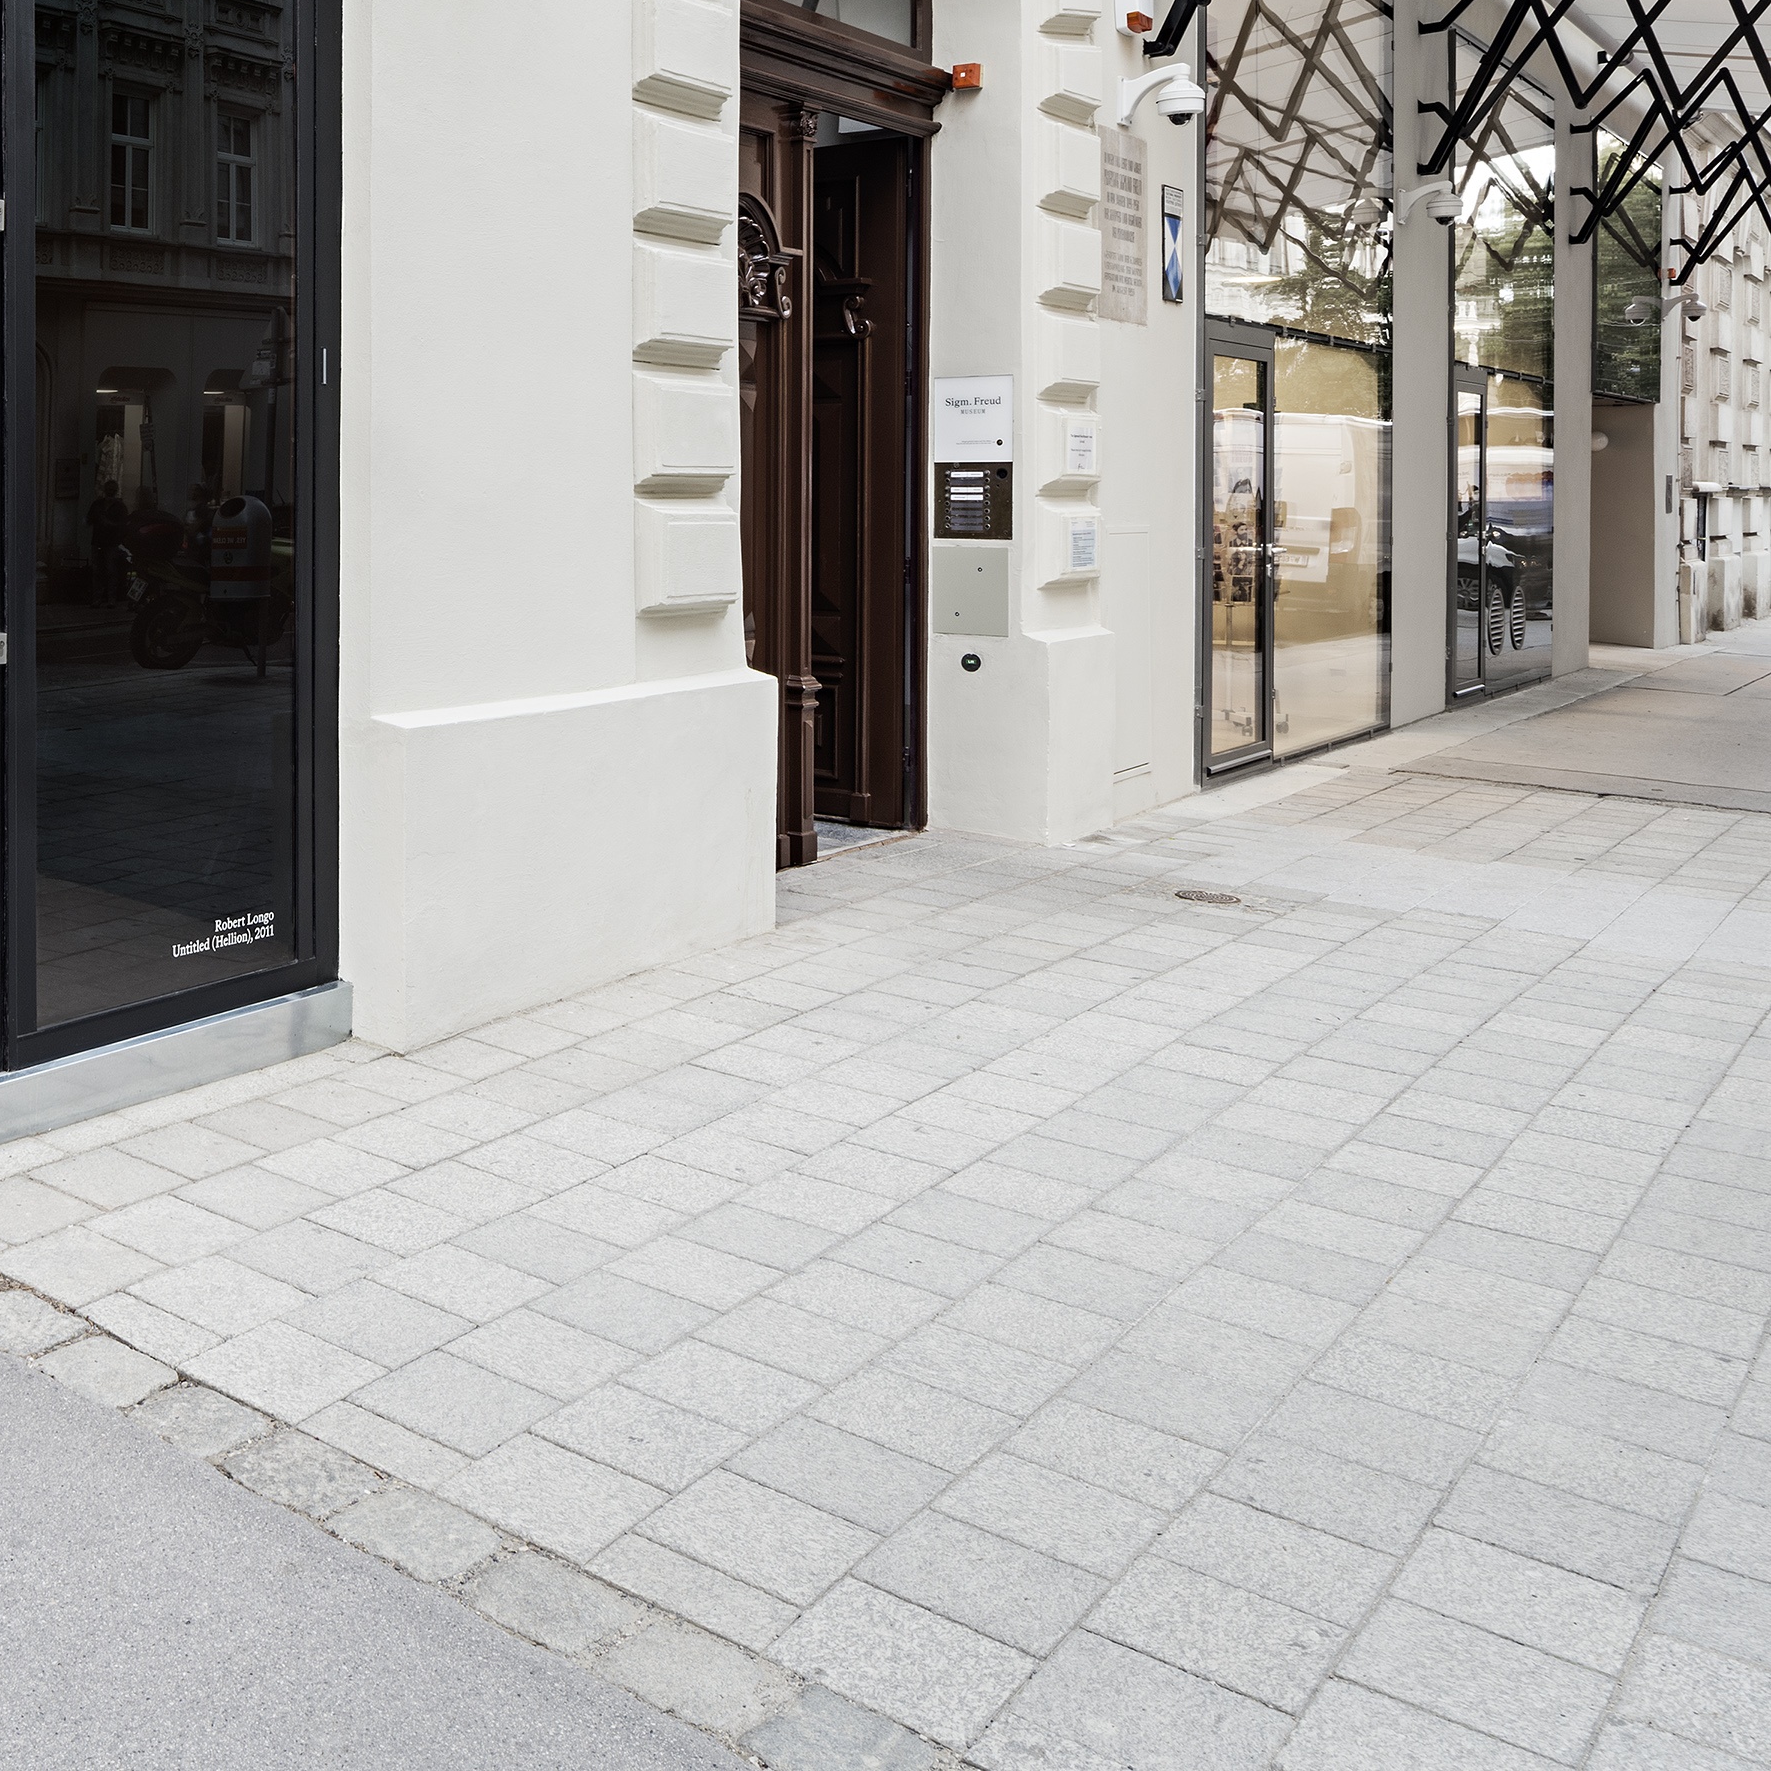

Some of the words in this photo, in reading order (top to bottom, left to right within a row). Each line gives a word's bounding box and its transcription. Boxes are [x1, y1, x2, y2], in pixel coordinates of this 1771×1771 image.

[945, 397, 972, 408] Sigm.
[974, 396, 1001, 406] Freud
[215, 917, 245, 932] Robert
[247, 911, 275, 926] Longo
[172, 938, 210, 957] Untitled
[212, 928, 253, 951] (Hellion),
[254, 925, 274, 940] 2011
